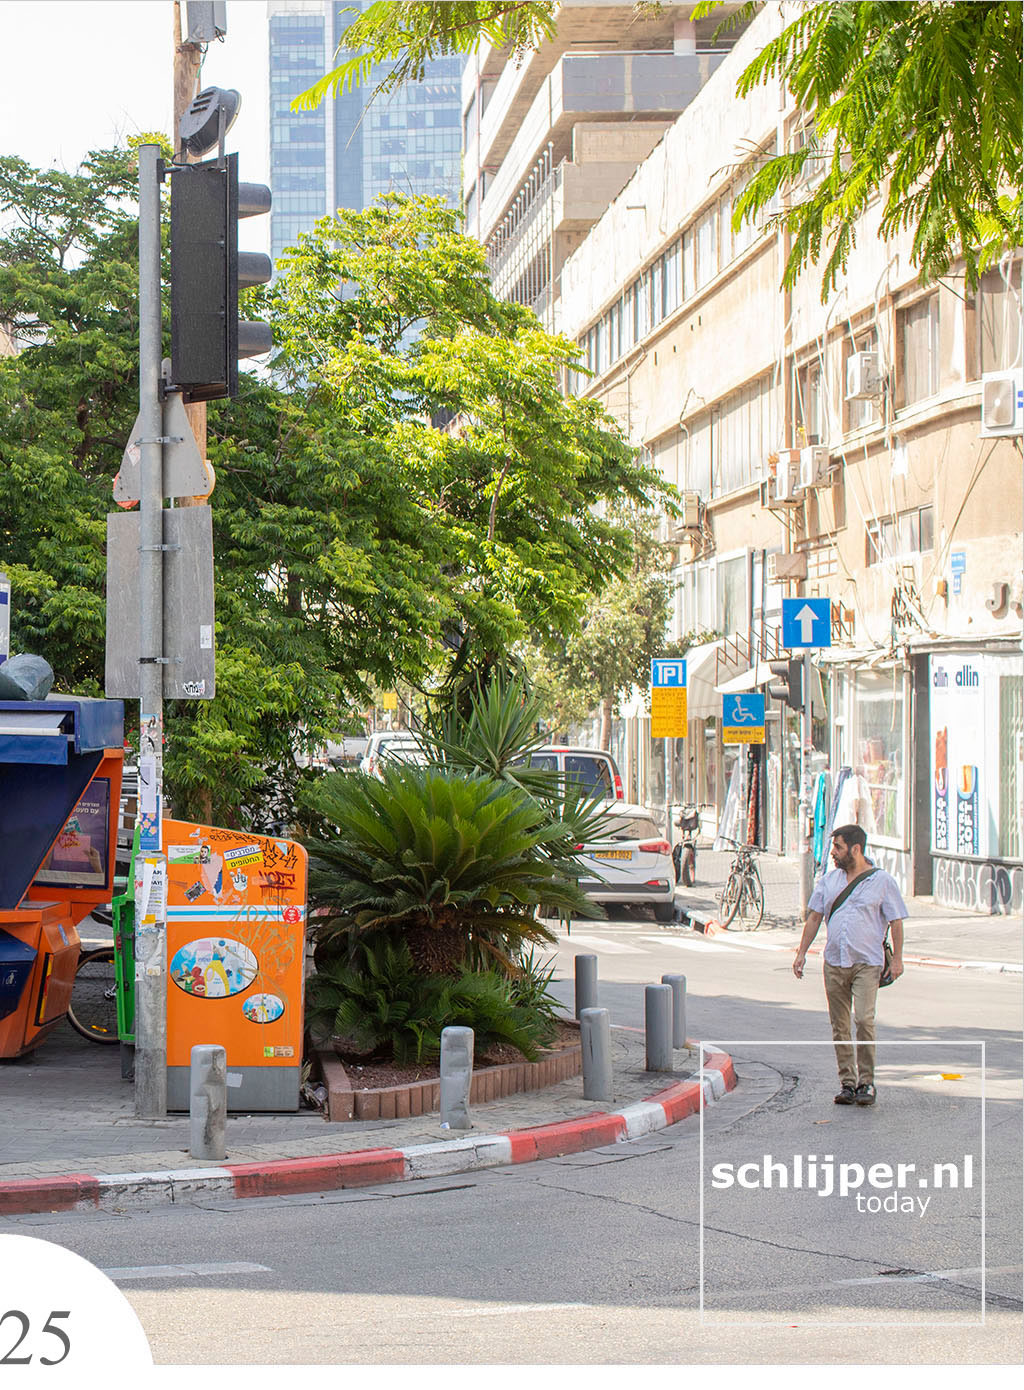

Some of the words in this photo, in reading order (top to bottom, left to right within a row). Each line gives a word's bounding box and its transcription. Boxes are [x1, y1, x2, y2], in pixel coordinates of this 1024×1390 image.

[955, 664, 979, 687] allin
[965, 800, 974, 855] SOFT
[230, 855, 260, 869] החטופים
